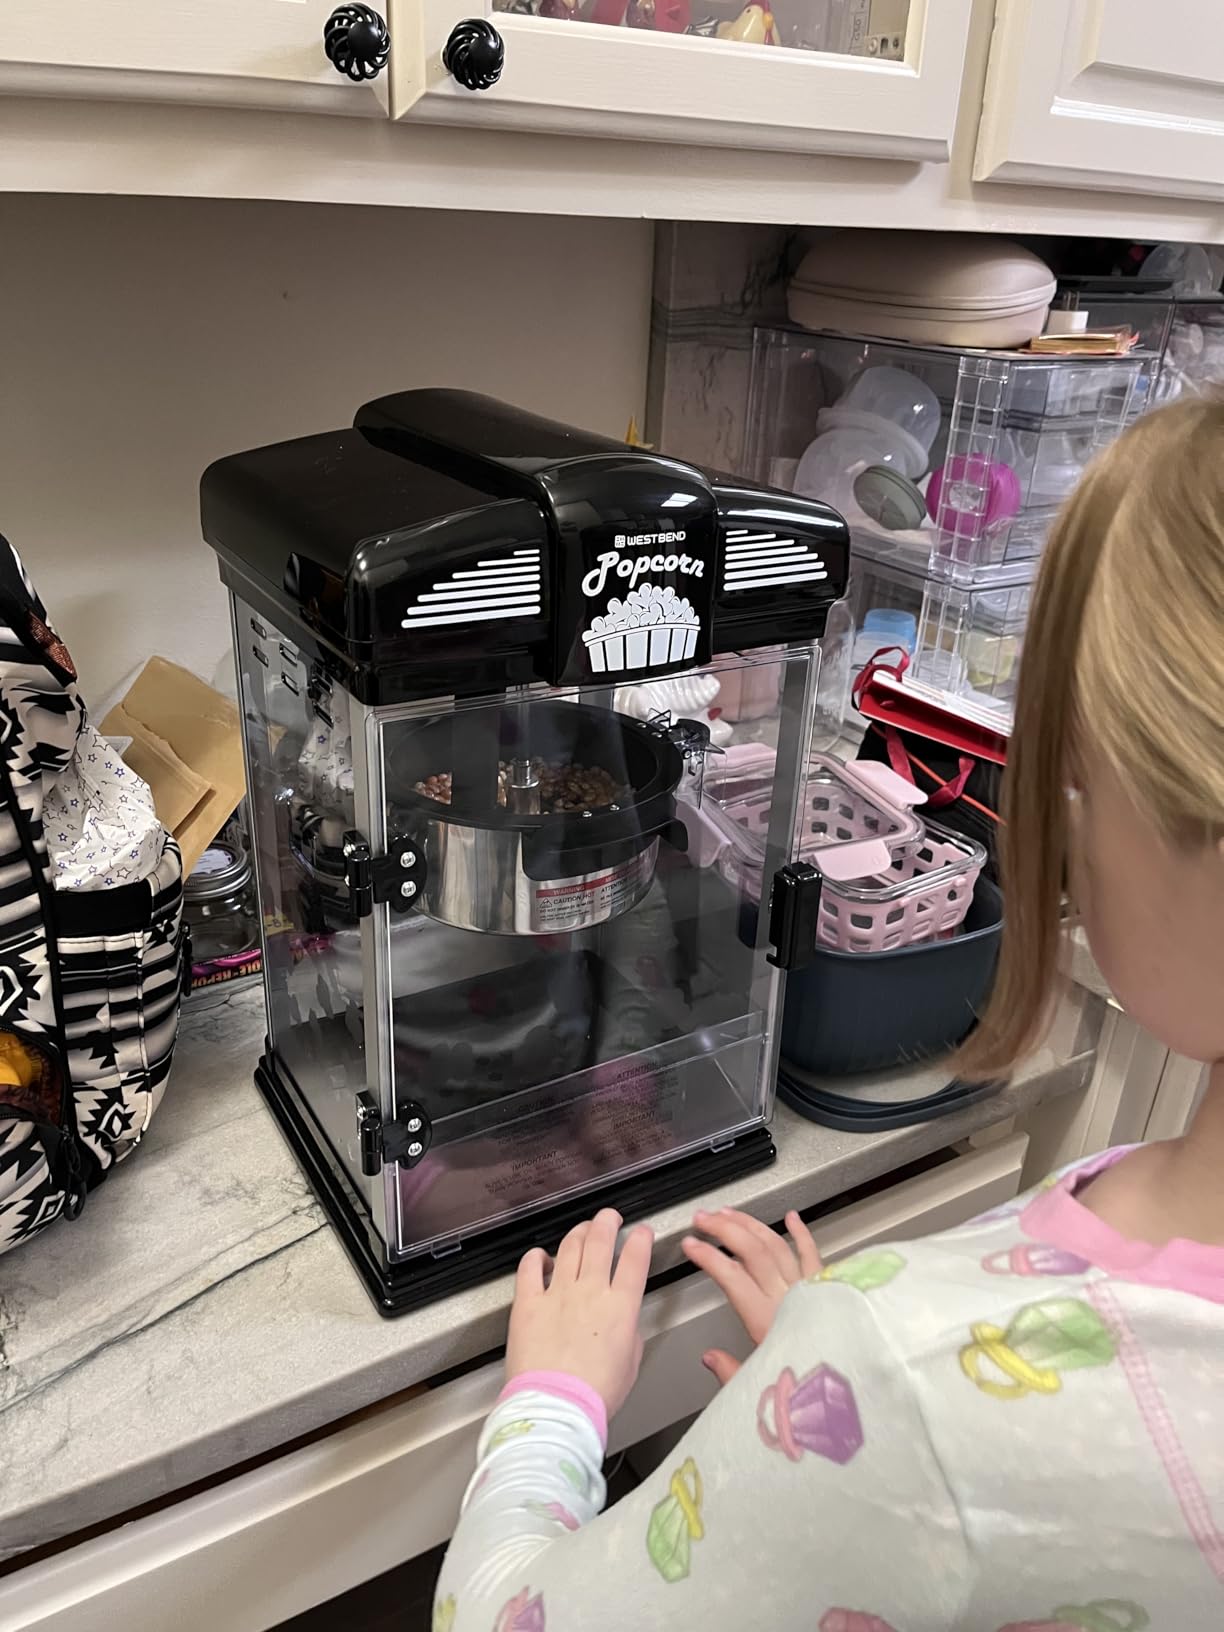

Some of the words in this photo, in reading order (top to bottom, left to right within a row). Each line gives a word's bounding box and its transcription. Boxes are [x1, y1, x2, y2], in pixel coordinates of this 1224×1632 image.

[581, 551, 704, 597] Popcorn
[553, 885, 585, 896] WARNING
[613, 1111, 656, 1130] IMPORTANT
[512, 1150, 558, 1172] IMPORTANT
